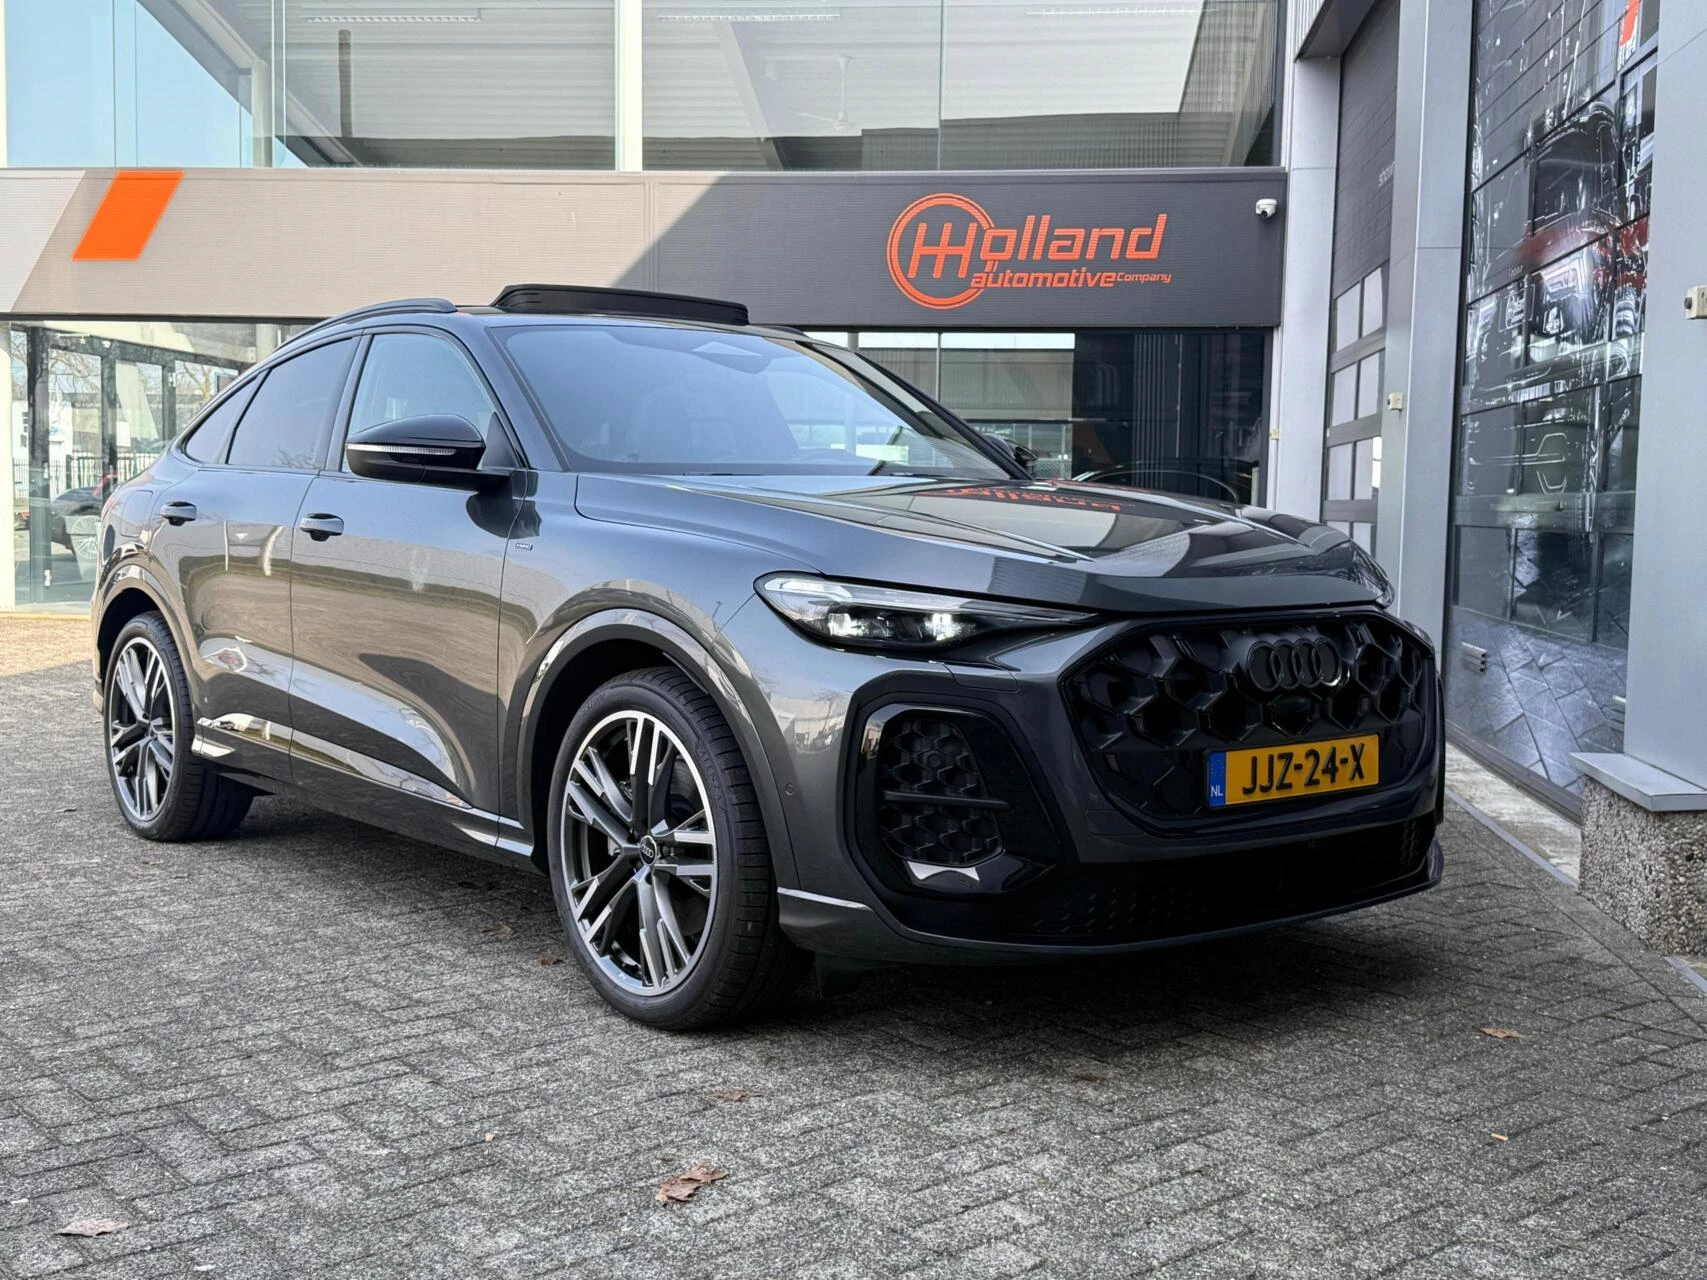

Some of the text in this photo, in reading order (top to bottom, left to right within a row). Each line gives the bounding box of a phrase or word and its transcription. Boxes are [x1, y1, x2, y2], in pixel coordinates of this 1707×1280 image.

[970, 267, 1172, 288] automotive Company
[1242, 743, 1365, 795] JJZ-24-X
[1210, 785, 1224, 798] NL
